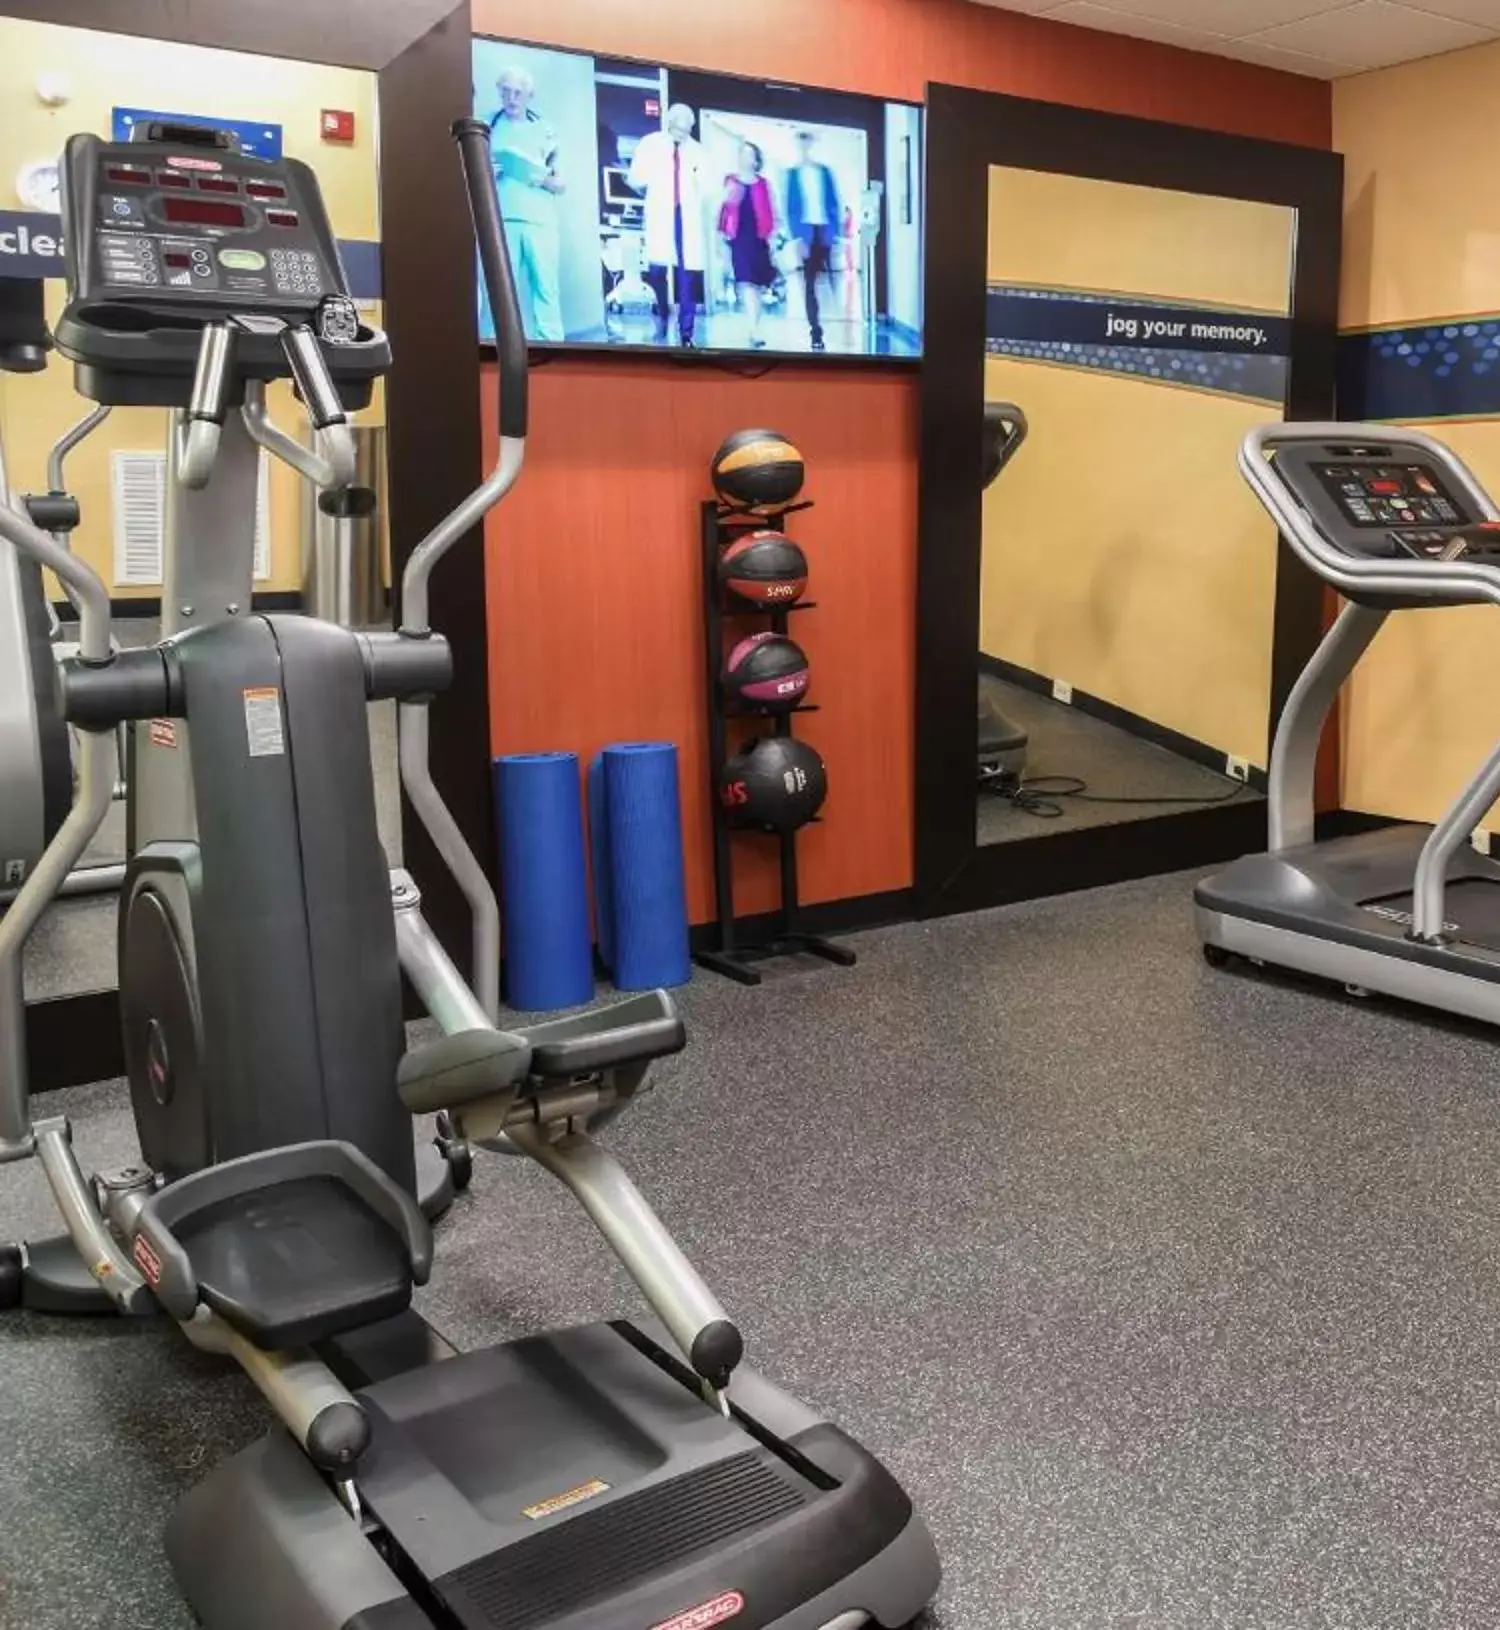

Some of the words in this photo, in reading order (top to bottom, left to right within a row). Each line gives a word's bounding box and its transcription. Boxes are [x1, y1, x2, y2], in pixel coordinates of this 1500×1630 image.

[1105, 313, 1138, 338] jog
[1143, 319, 1186, 339] your
[1191, 323, 1268, 346] memory.
